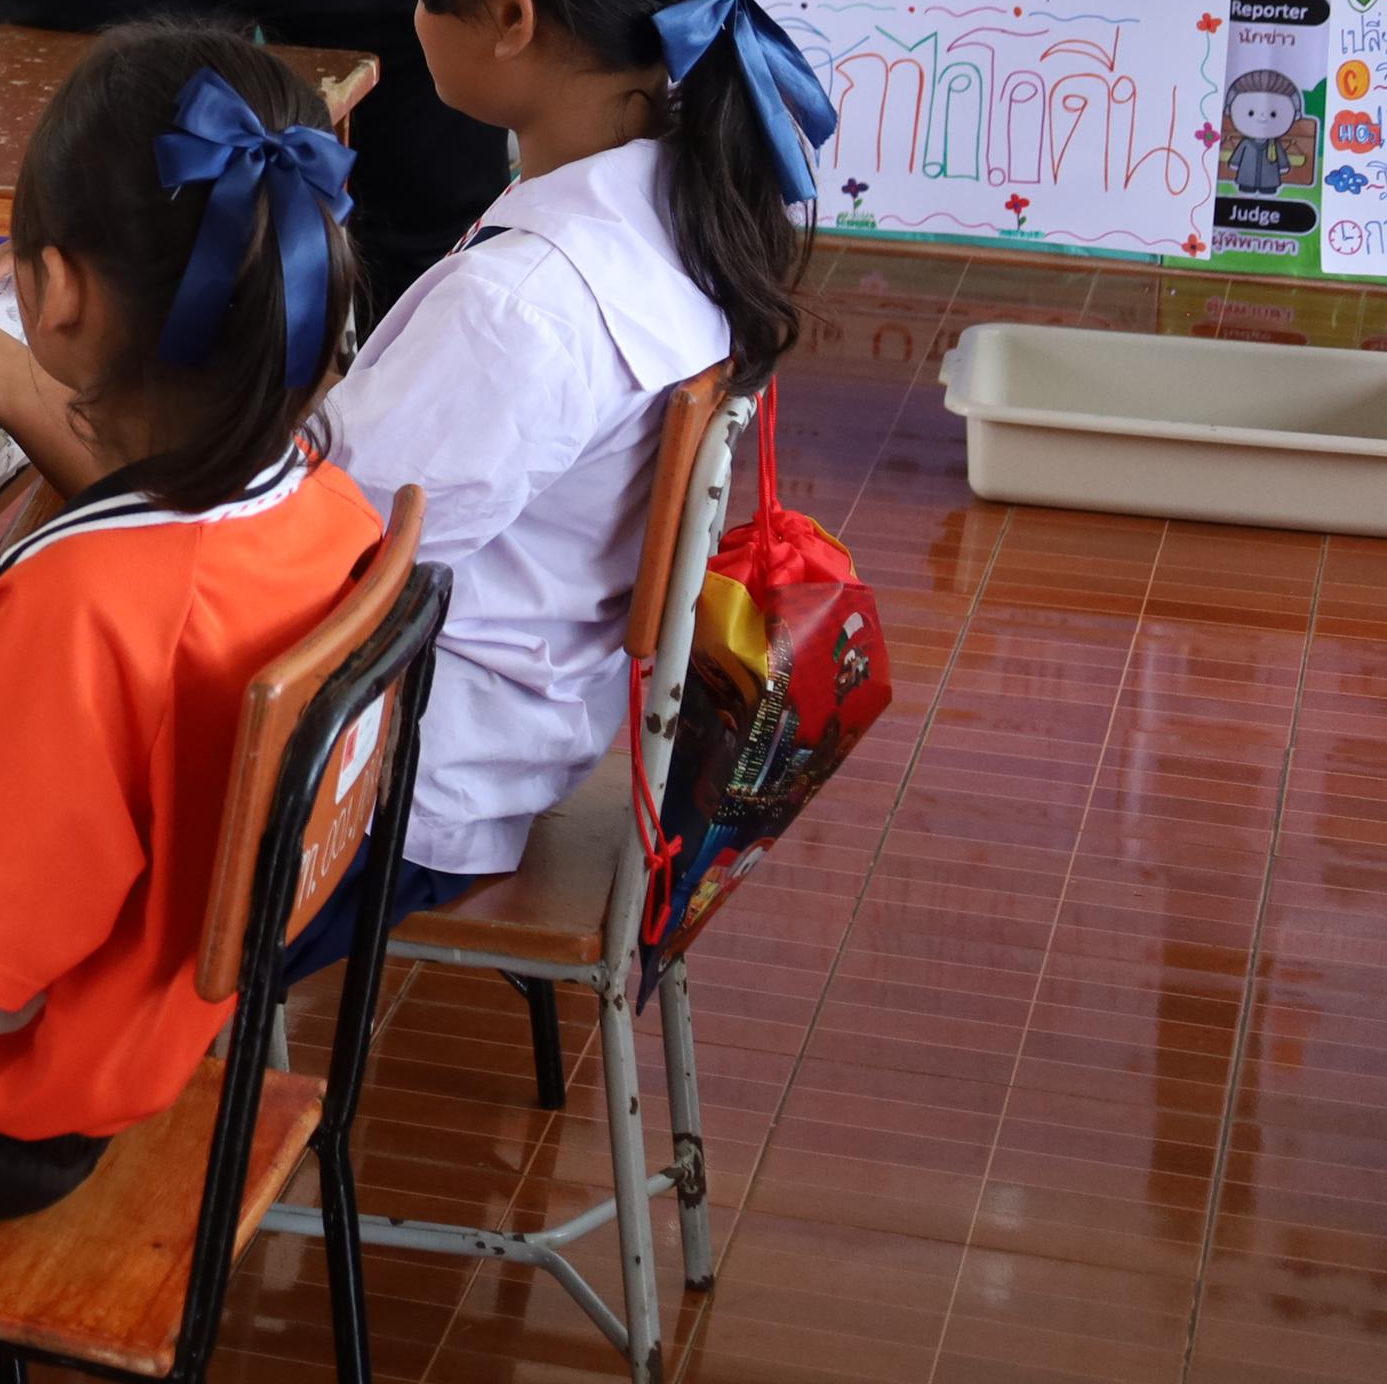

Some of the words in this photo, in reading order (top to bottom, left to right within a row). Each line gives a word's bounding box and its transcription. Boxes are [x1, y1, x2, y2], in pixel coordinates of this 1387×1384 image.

[1231, 0, 1309, 21] Reporter
[1239, 27, 1296, 46] นักข่าว
[1229, 204, 1281, 226] Judge
[1212, 232, 1296, 253] ผู้พิพากษา
